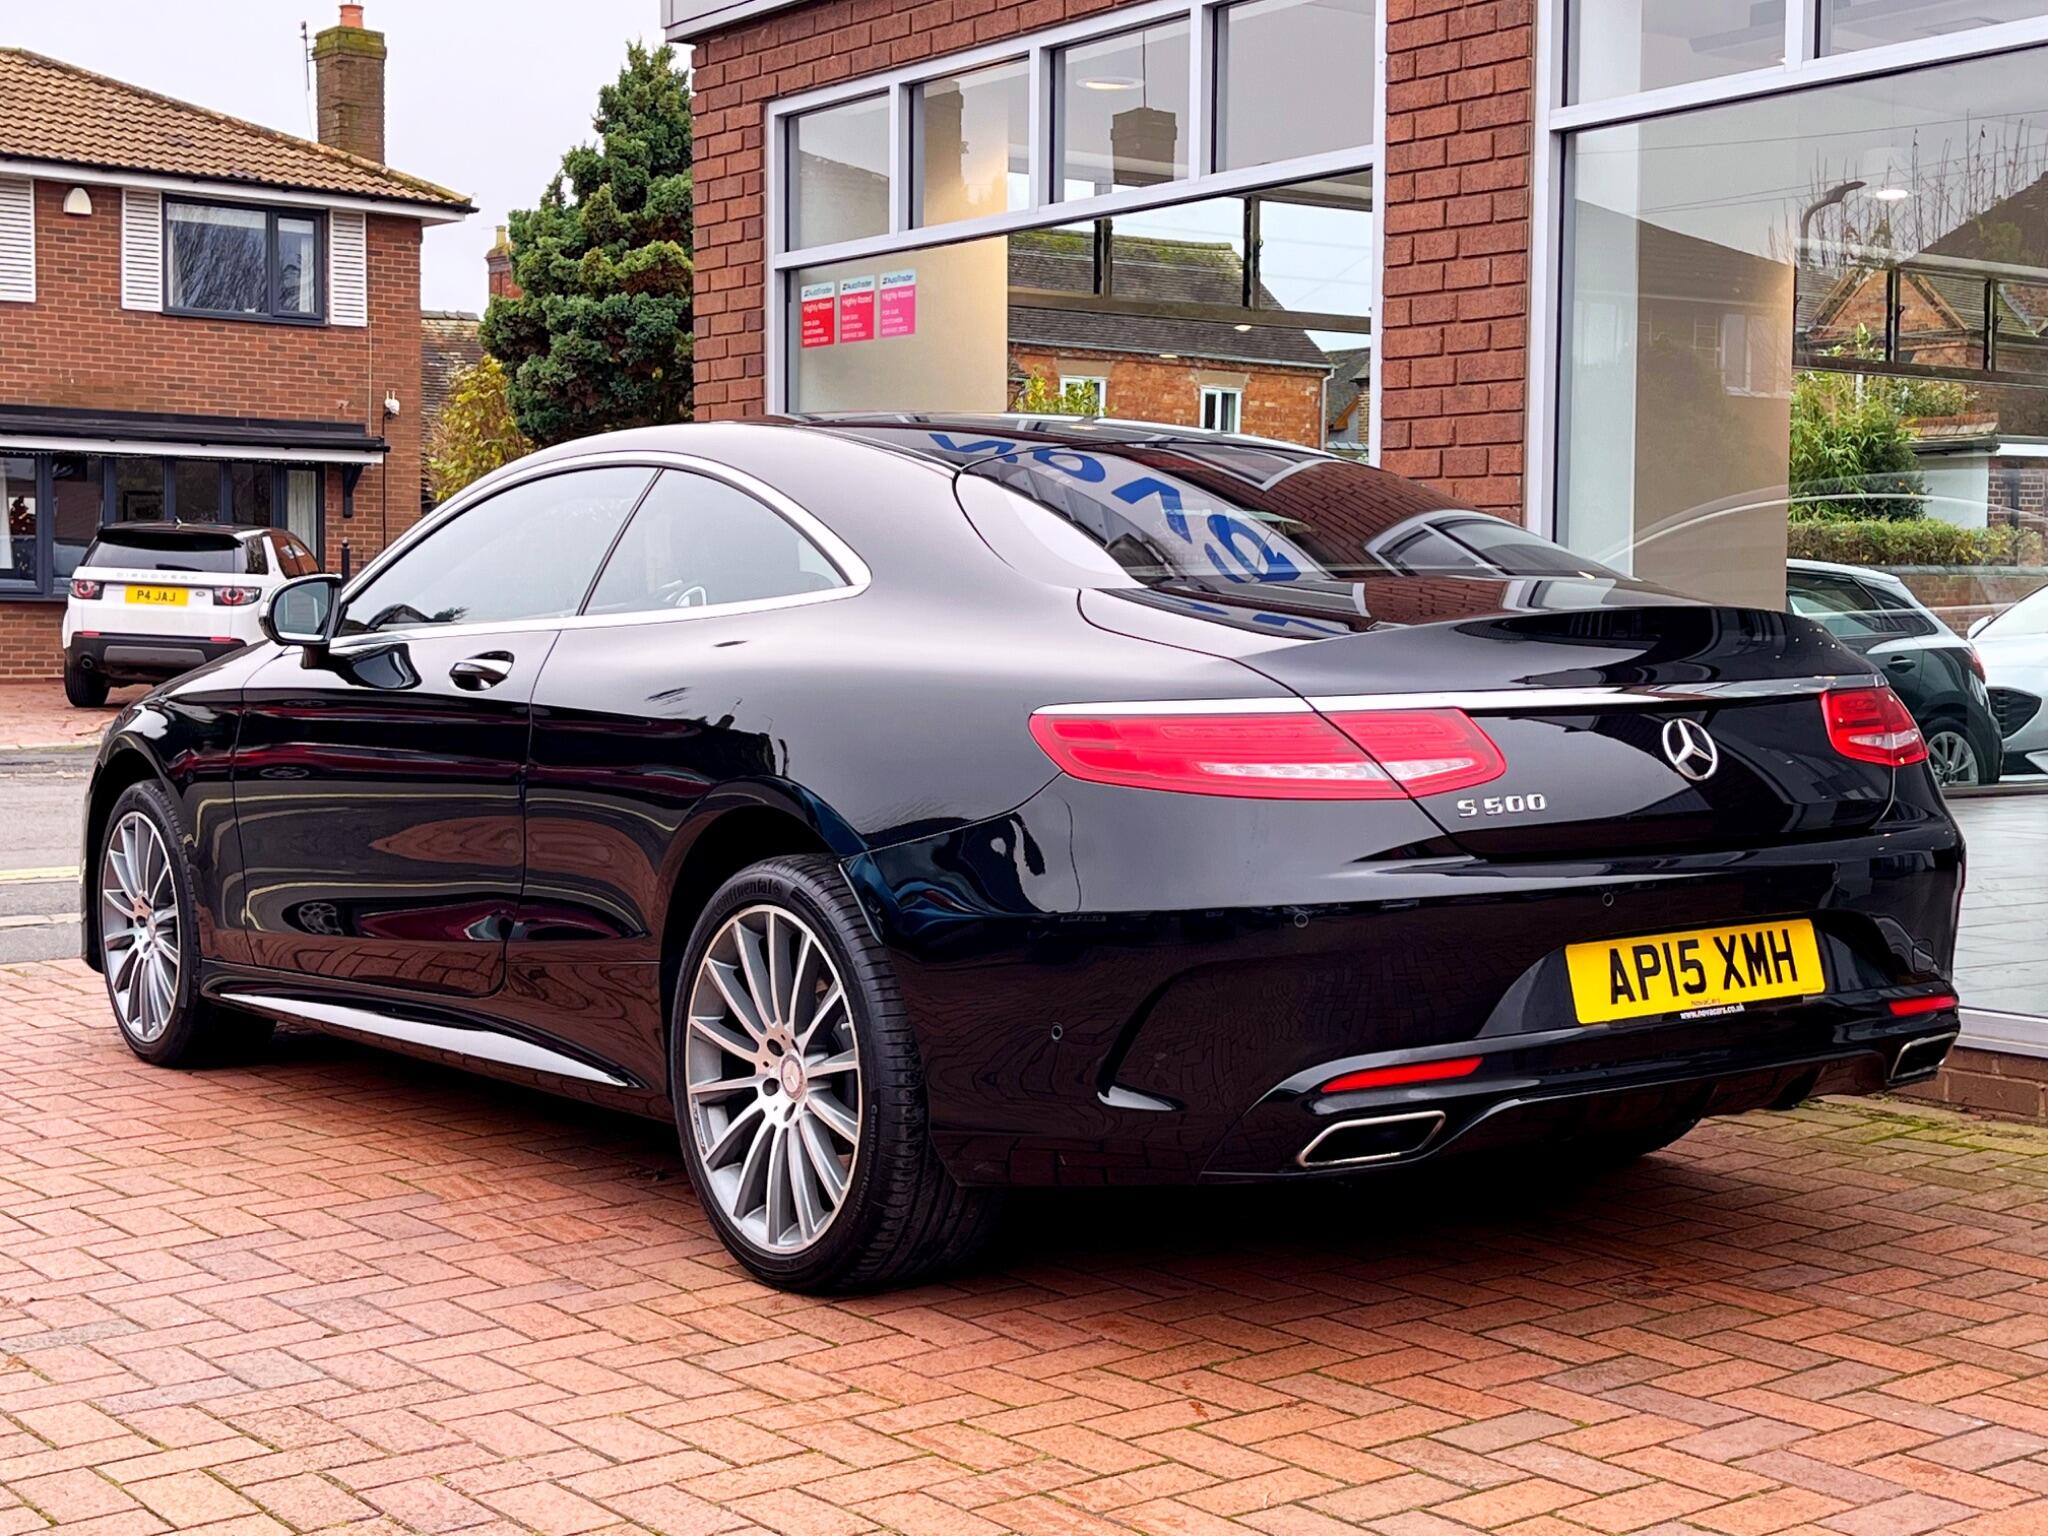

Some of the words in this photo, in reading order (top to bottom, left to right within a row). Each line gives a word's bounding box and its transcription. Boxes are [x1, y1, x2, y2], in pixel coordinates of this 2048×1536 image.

[136, 589, 151, 601] P4
[154, 591, 176, 603] JAJ
[1457, 798, 1478, 817] S
[1483, 793, 1547, 816] 500
[1608, 938, 1707, 1005] AP15
[1713, 928, 1798, 991] XMH
